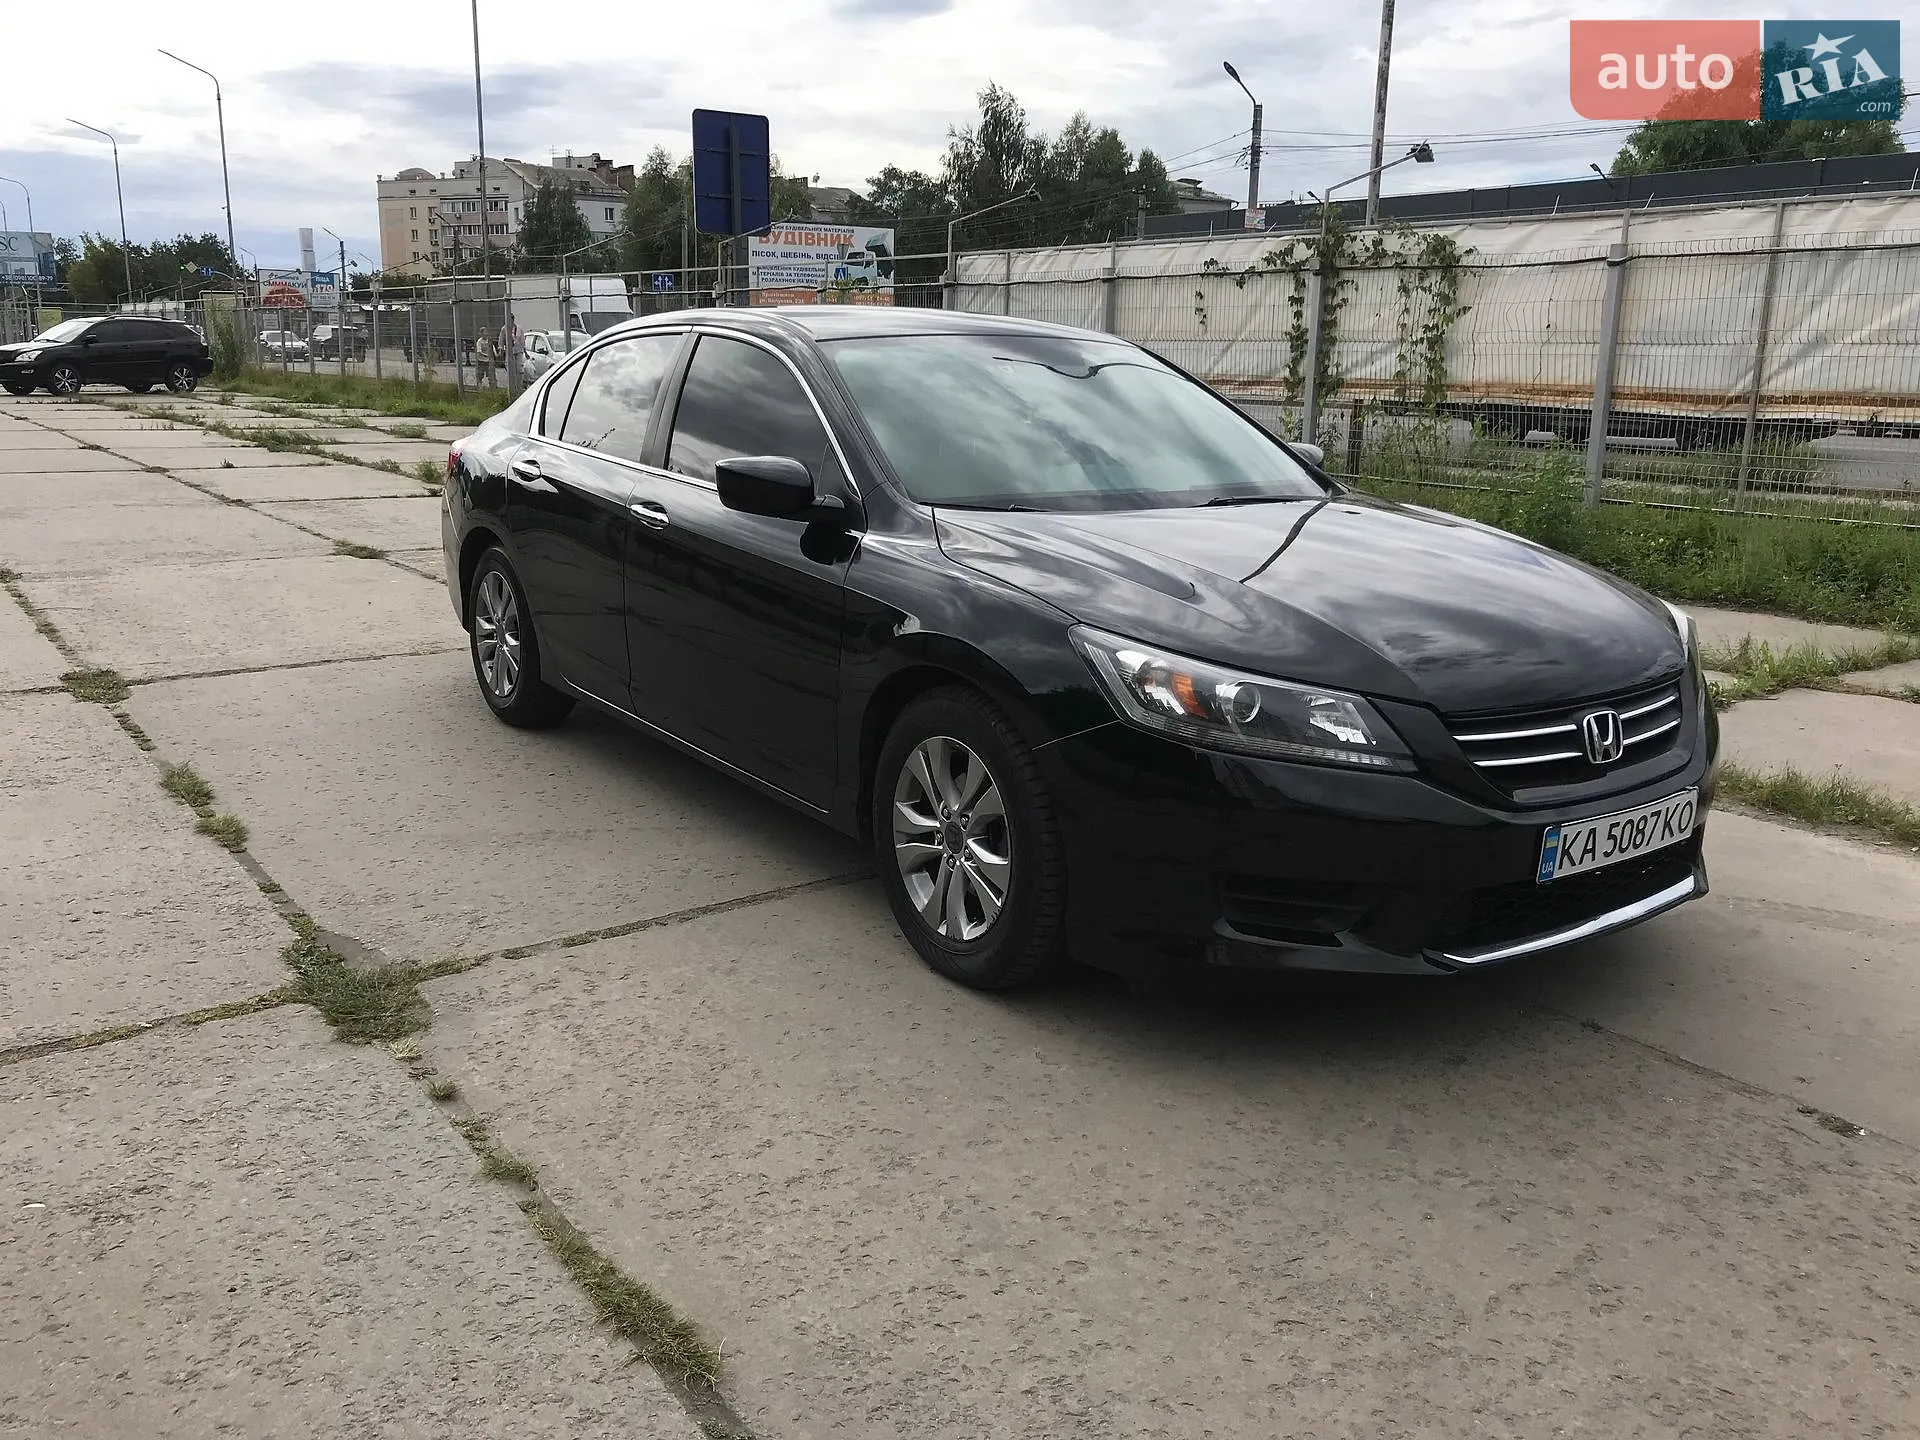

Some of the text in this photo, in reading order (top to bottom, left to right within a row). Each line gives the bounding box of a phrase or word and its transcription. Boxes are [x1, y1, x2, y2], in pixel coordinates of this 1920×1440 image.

[758, 230, 855, 248] БУДІВНИК
[1558, 826, 1597, 870] KA
[1602, 810, 1661, 858] 5087
[1541, 861, 1553, 874] UA
